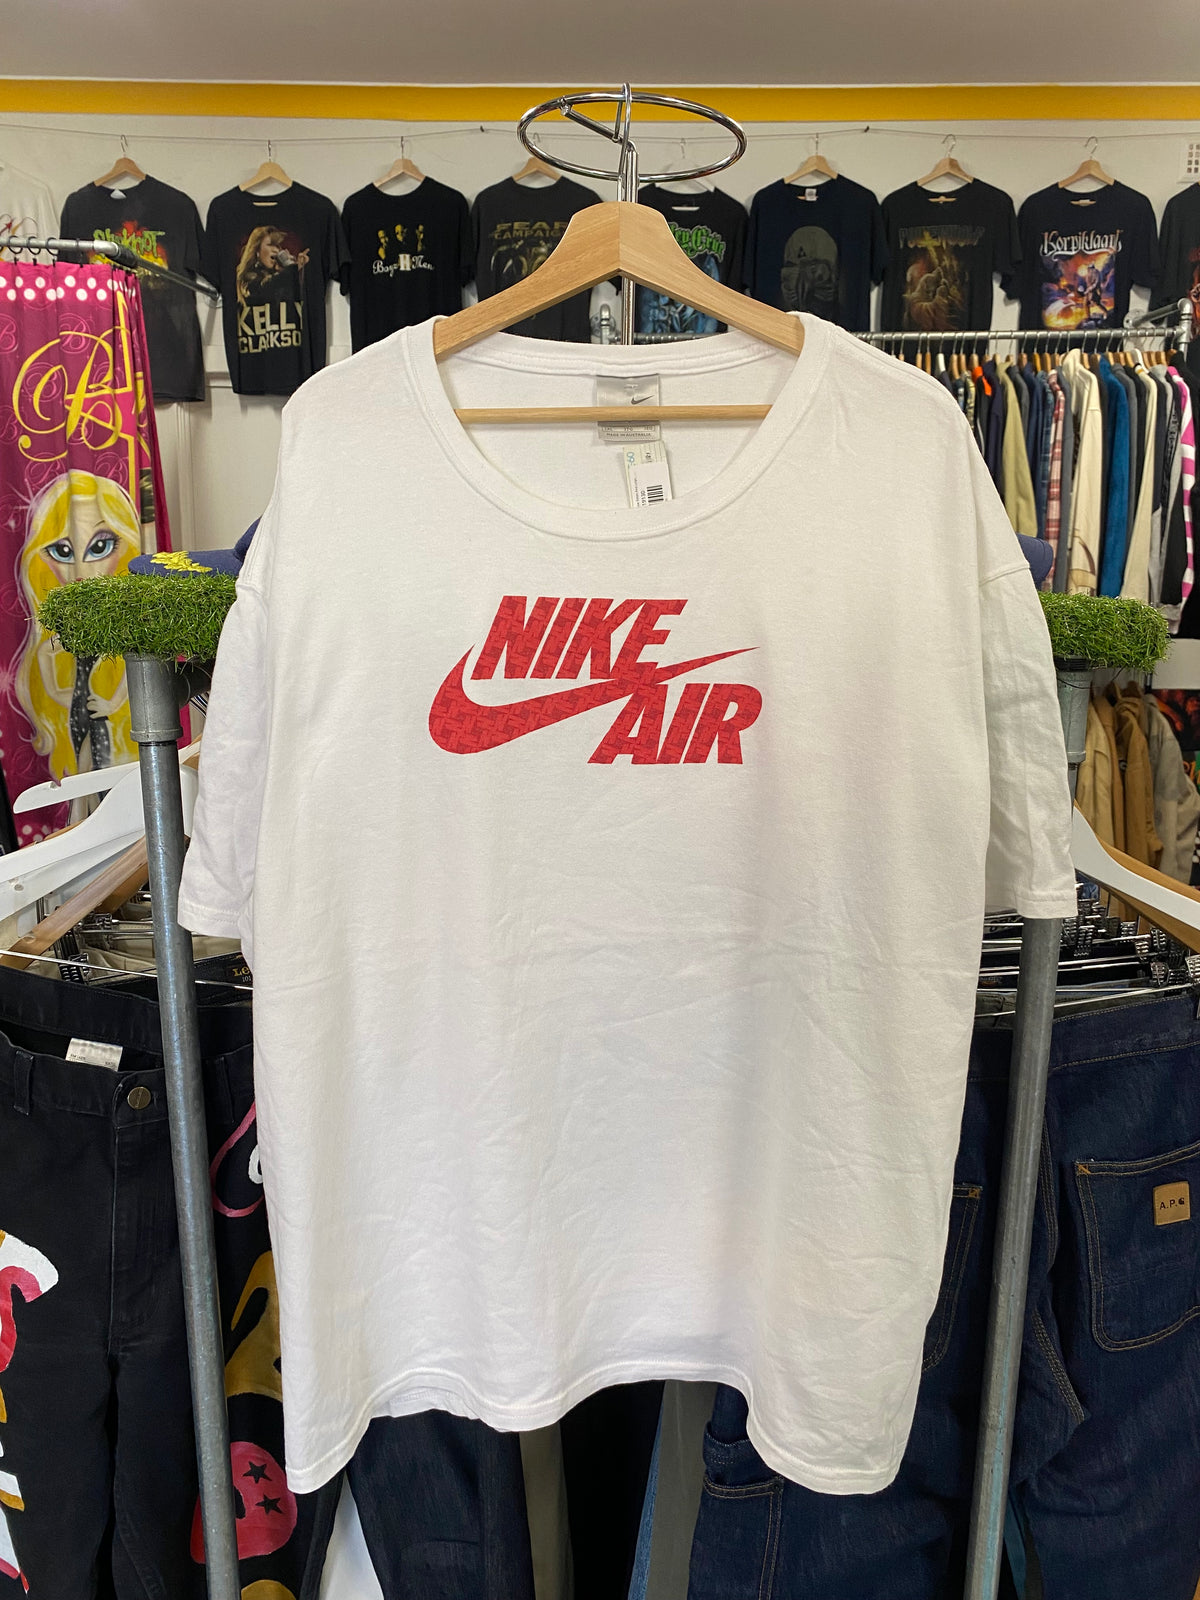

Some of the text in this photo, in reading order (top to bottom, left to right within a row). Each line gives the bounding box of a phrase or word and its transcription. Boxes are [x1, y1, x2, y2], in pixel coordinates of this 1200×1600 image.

[237, 301, 304, 337] KELLY
[470, 595, 688, 680] NIKE
[587, 682, 763, 765] AIR
